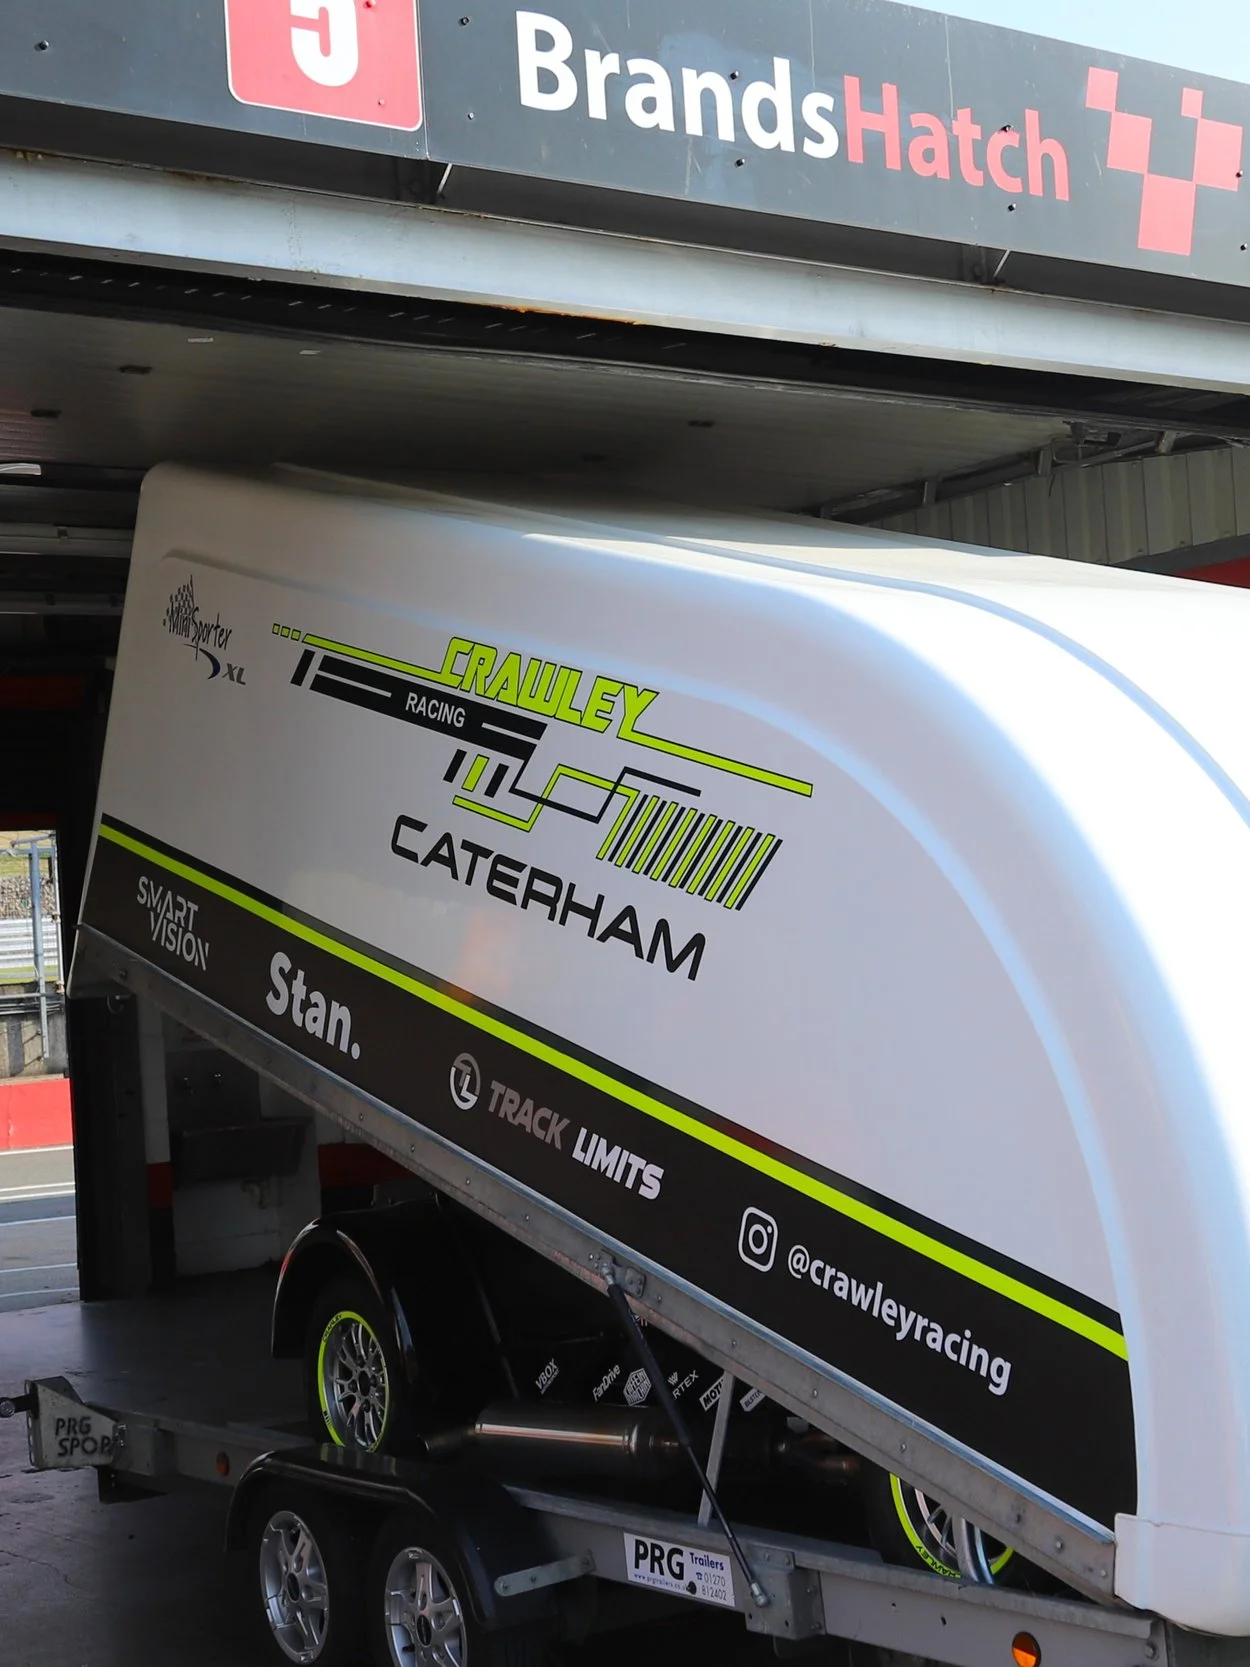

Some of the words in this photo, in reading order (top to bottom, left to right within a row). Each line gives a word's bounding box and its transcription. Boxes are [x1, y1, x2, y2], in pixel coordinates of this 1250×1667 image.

[221, 662, 246, 685] XL
[438, 636, 660, 740] CRAWLEY
[404, 692, 466, 729] RACING
[136, 875, 199, 932] SMART
[390, 814, 707, 981] CATERHAM
[265, 951, 361, 1060] Stan.
[488, 1079, 571, 1151] TRACK
[571, 1126, 665, 1200] LIMITS
[788, 1244, 1012, 1396] @crawleyracing
[535, 1358, 559, 1390] VBOX
[592, 1364, 621, 1402] FanDrive
[671, 1369, 700, 1400] RTEX
[55, 1417, 91, 1436] PRG
[634, 1539, 685, 1580] PRG
[689, 1551, 725, 1571] Trailers
[701, 1584, 727, 1601] 812402
[704, 1571, 726, 1587] 01270
